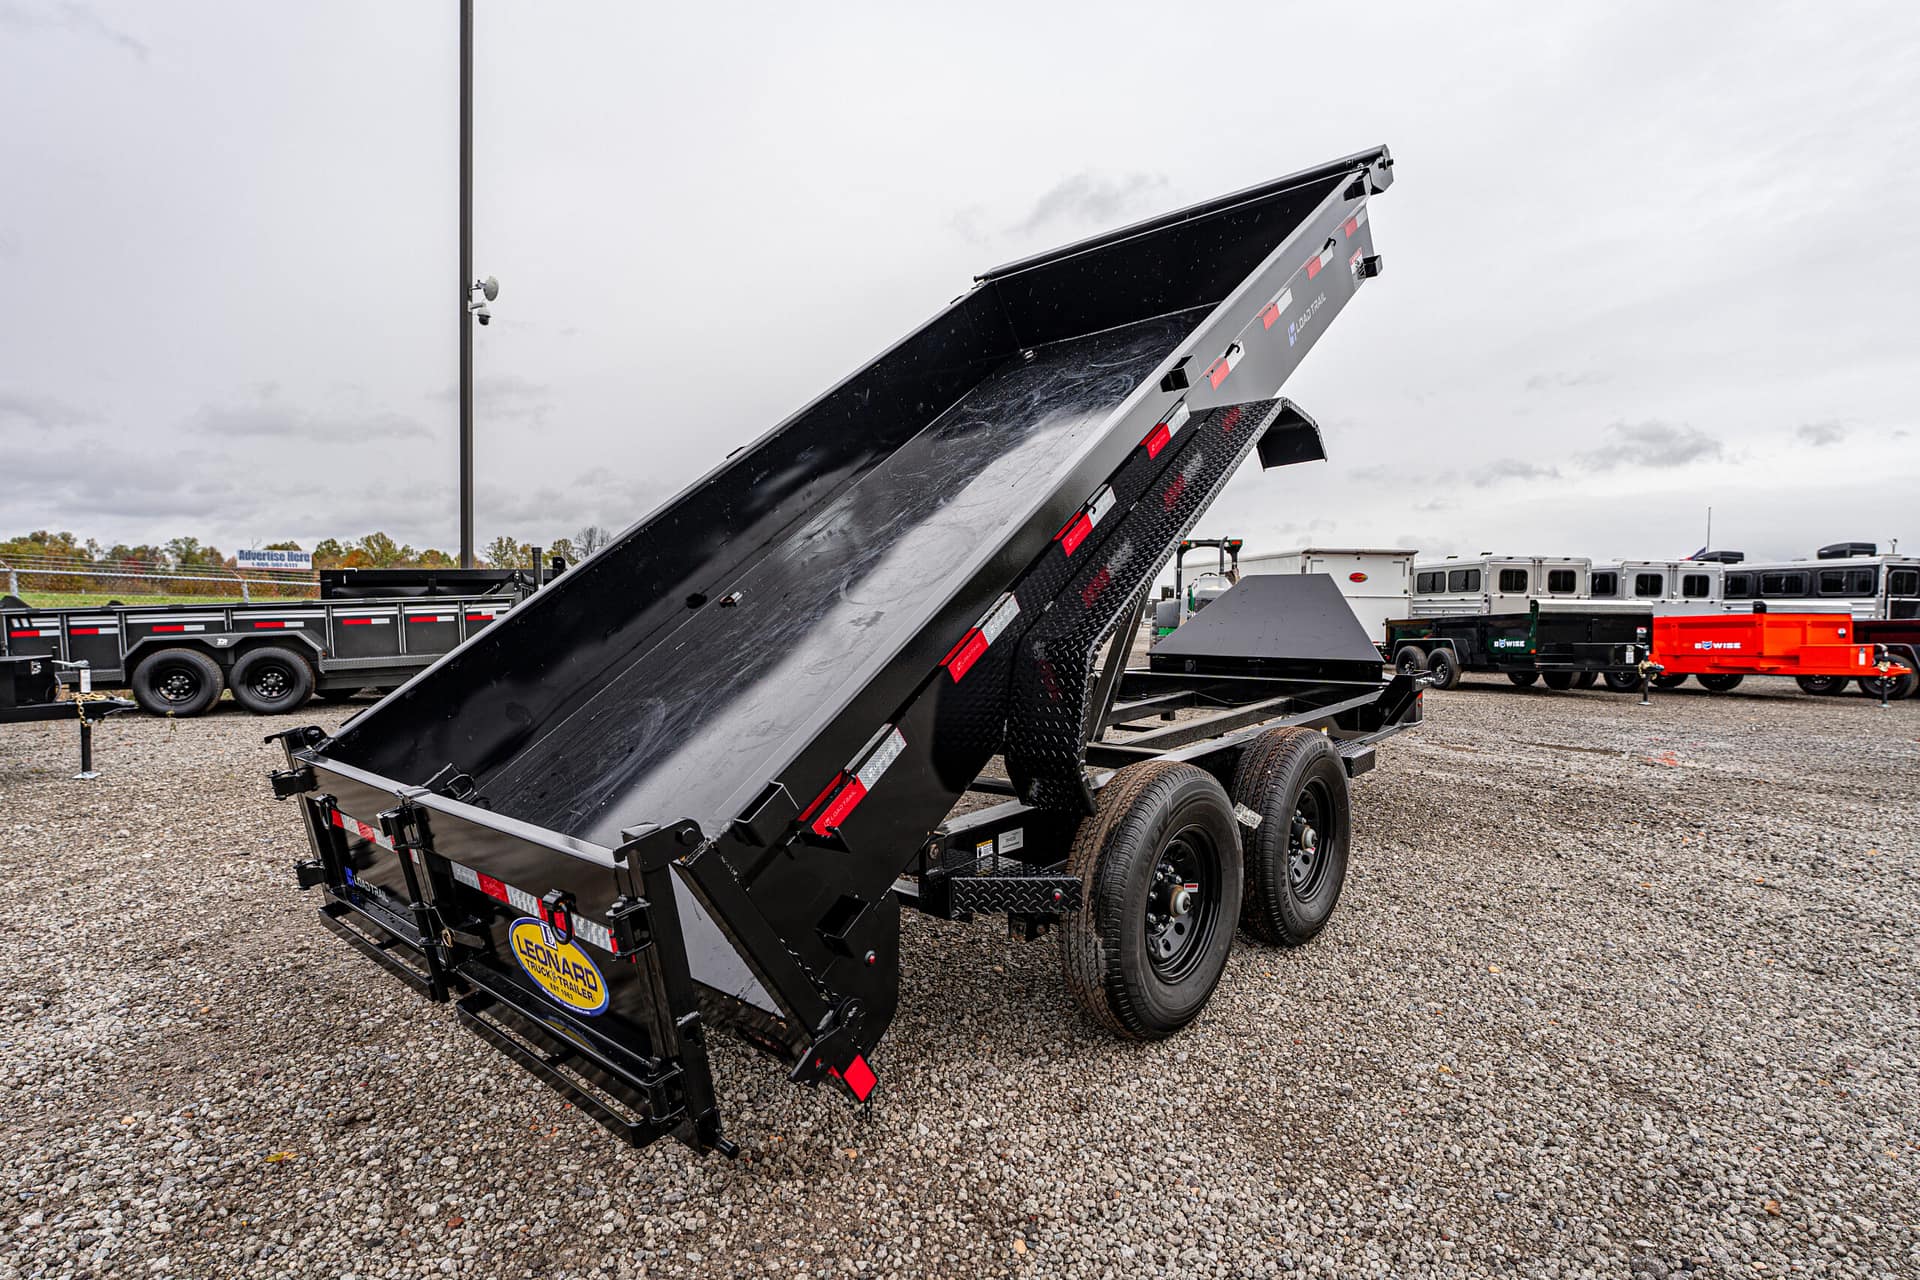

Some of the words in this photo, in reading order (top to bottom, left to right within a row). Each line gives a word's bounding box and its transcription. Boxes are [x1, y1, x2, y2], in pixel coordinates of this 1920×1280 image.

[238, 550, 286, 562] Advertise
[287, 551, 310, 562] Here
[516, 934, 598, 992] LEONARD
[525, 958, 552, 979] TRUCK
[557, 975, 595, 1002] TRAILER
